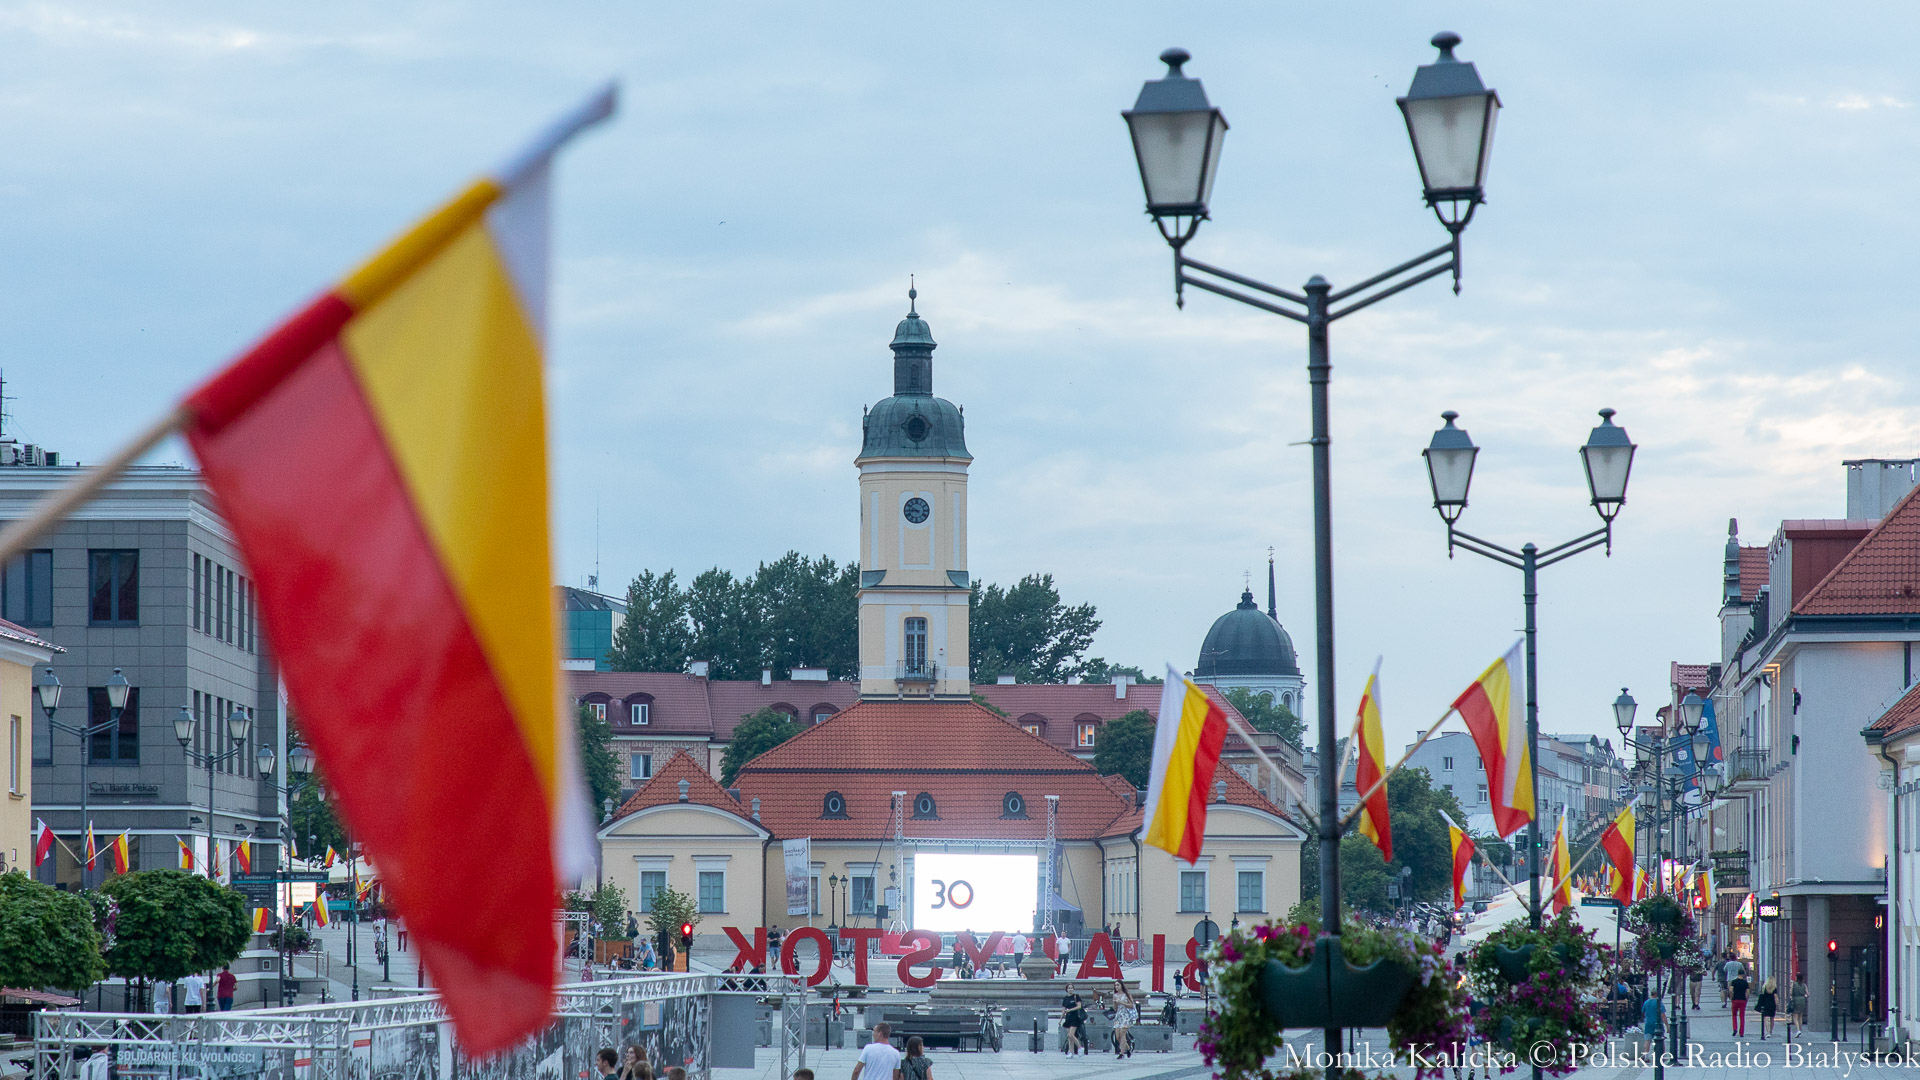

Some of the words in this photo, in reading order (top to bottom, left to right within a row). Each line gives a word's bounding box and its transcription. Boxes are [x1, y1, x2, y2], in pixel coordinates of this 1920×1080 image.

[110, 783, 130, 792] Bank
[132, 783, 158, 792] Pekao
[931, 879, 974, 910] 30
[117, 1051, 177, 1061] SOLIDARNIE
[181, 1051, 196, 1062] KU
[200, 1051, 255, 1063] WOLNOŚCI
